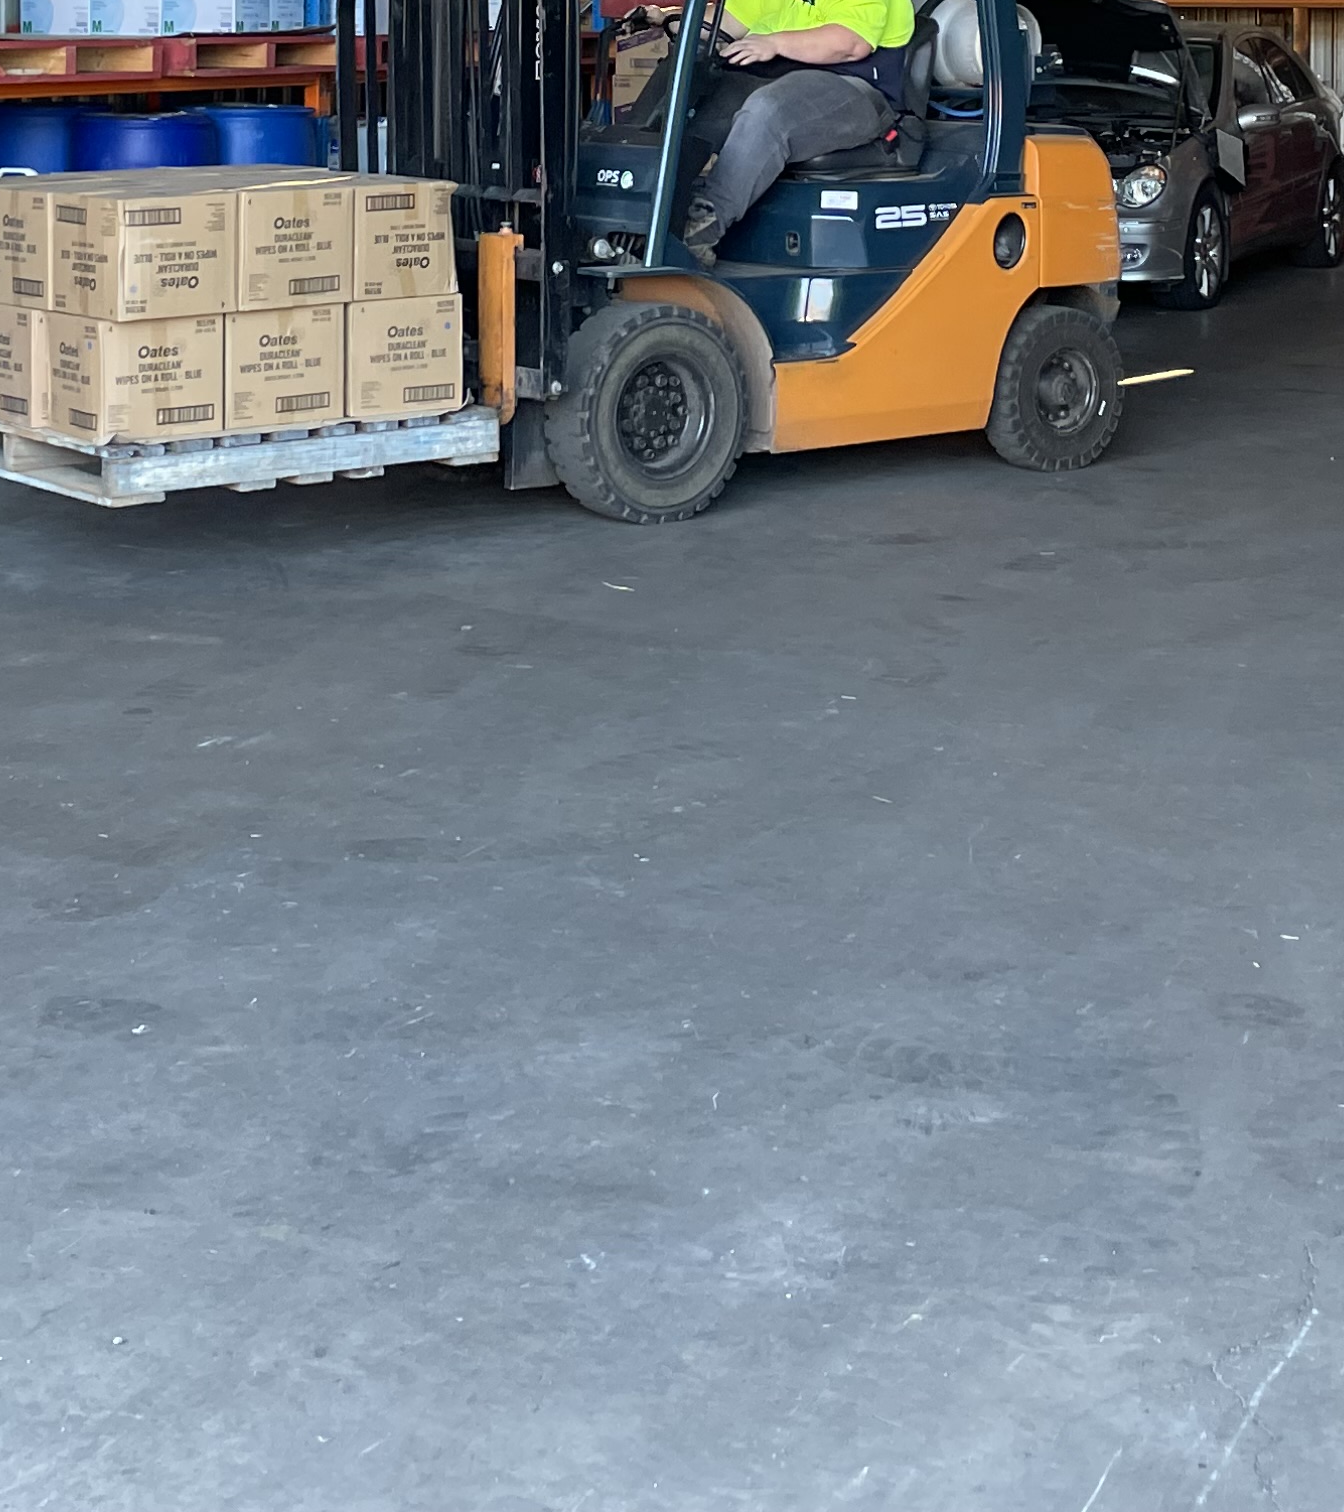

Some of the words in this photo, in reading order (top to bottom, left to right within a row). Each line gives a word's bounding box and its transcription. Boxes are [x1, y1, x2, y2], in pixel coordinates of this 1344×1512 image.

[597, 170, 619, 184] OPS
[3, 214, 23, 228] Oates
[274, 216, 310, 230] Oates
[874, 204, 927, 229] 25
[255, 245, 276, 255] WIPES
[396, 256, 430, 269] Oates
[160, 275, 199, 289] Oates
[387, 325, 424, 338] Oates
[259, 333, 298, 347] Oates
[388, 340, 428, 352] DURACLEAN
[59, 342, 78, 357] Oates
[138, 345, 179, 359] Oates
[259, 348, 301, 360] DURACLEAN
[370, 354, 390, 364] WIPES
[392, 353, 402, 363] ON
[410, 351, 425, 361] ROLL
[431, 348, 447, 358] BLUE
[138, 360, 183, 373] DURACLEAN
[240, 364, 261, 374] WIPES
[264, 363, 274, 373] ON
[282, 360, 298, 371] ROLL
[305, 358, 321, 368] BLUE
[116, 375, 139, 385] WIPES
[141, 374, 152, 384] ON
[185, 369, 202, 380] BLUE
